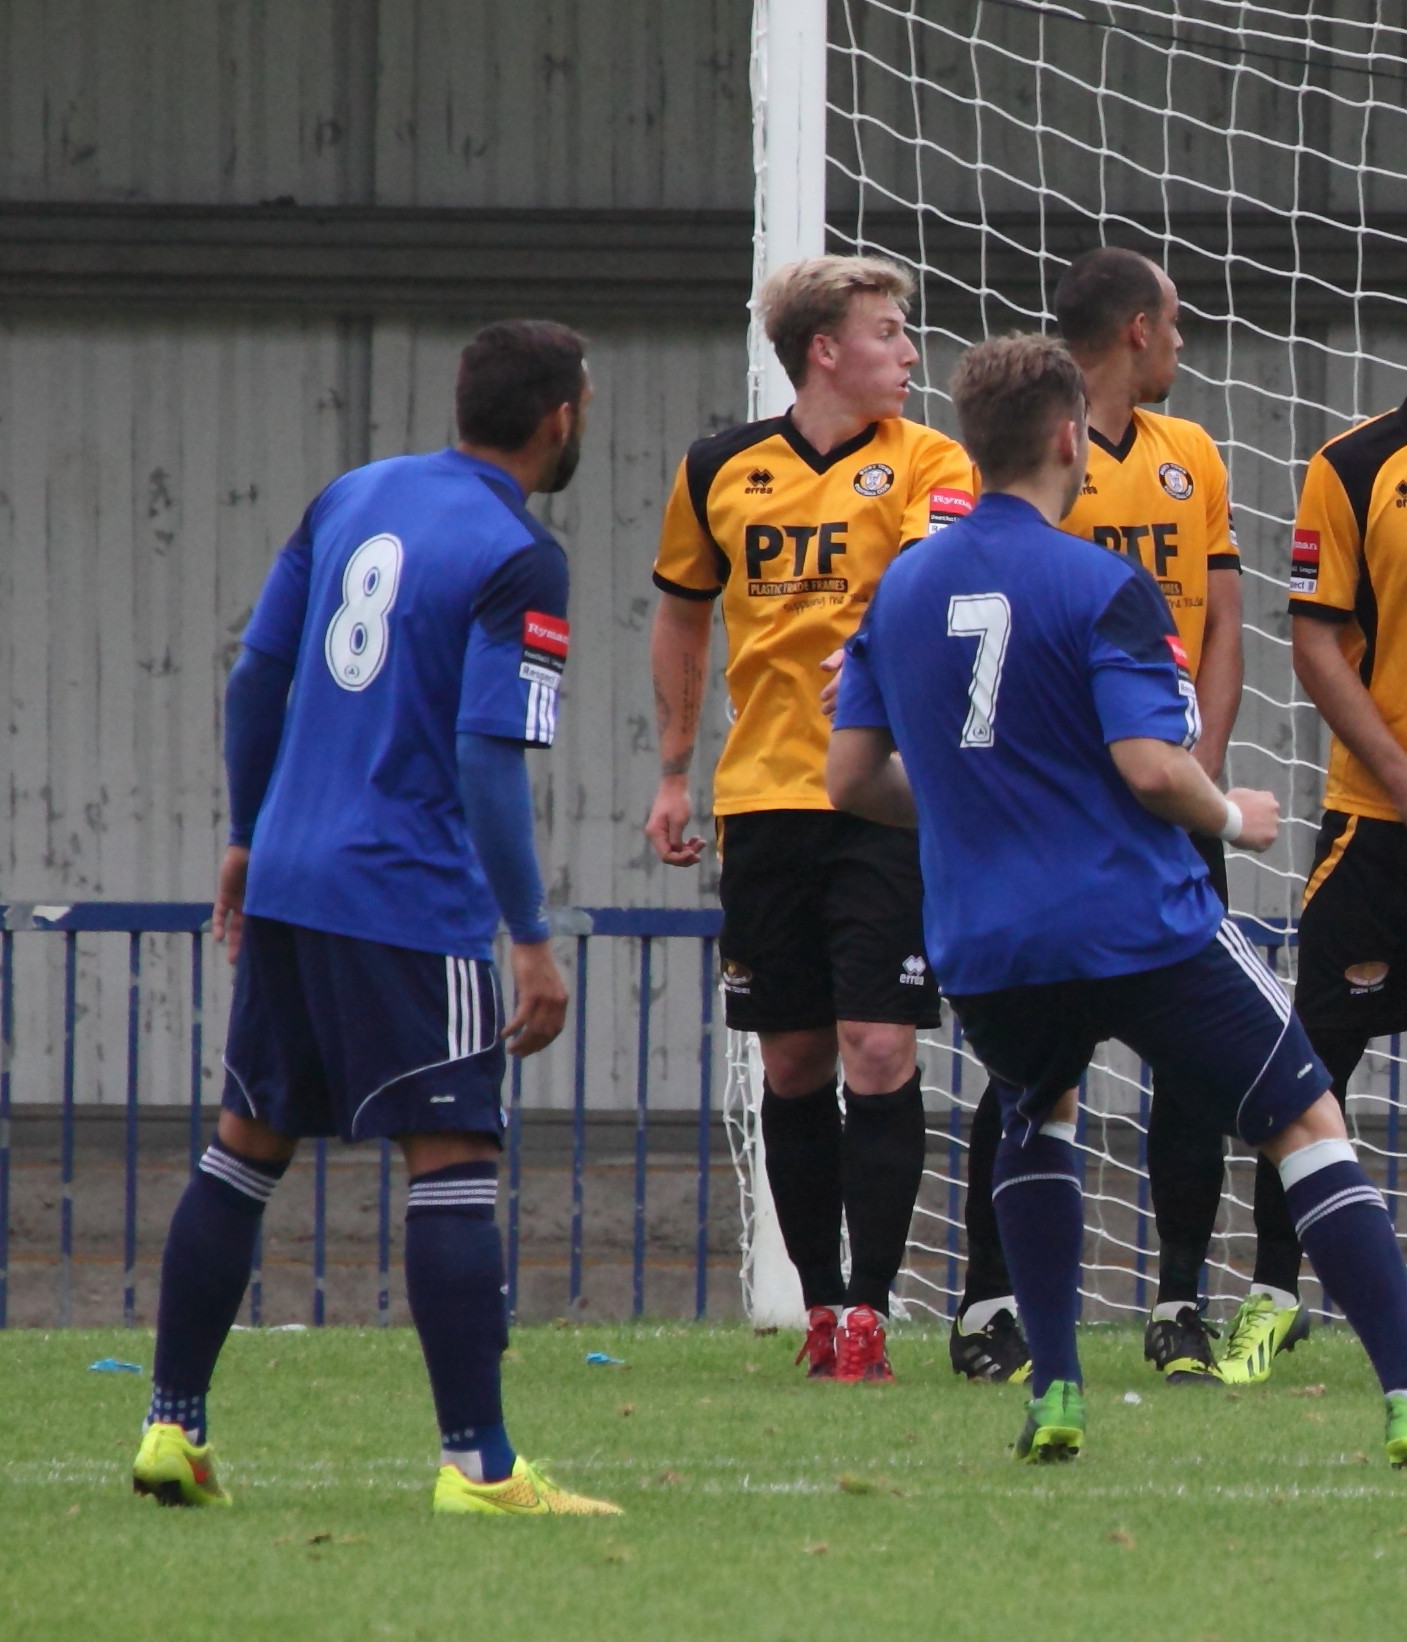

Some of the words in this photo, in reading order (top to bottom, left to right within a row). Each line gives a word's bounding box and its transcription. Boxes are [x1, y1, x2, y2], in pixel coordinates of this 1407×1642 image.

[745, 522, 848, 579] PTF
[751, 583, 782, 595] PLASTIC
[325, 533, 404, 691] 8
[946, 592, 1011, 748] 7
